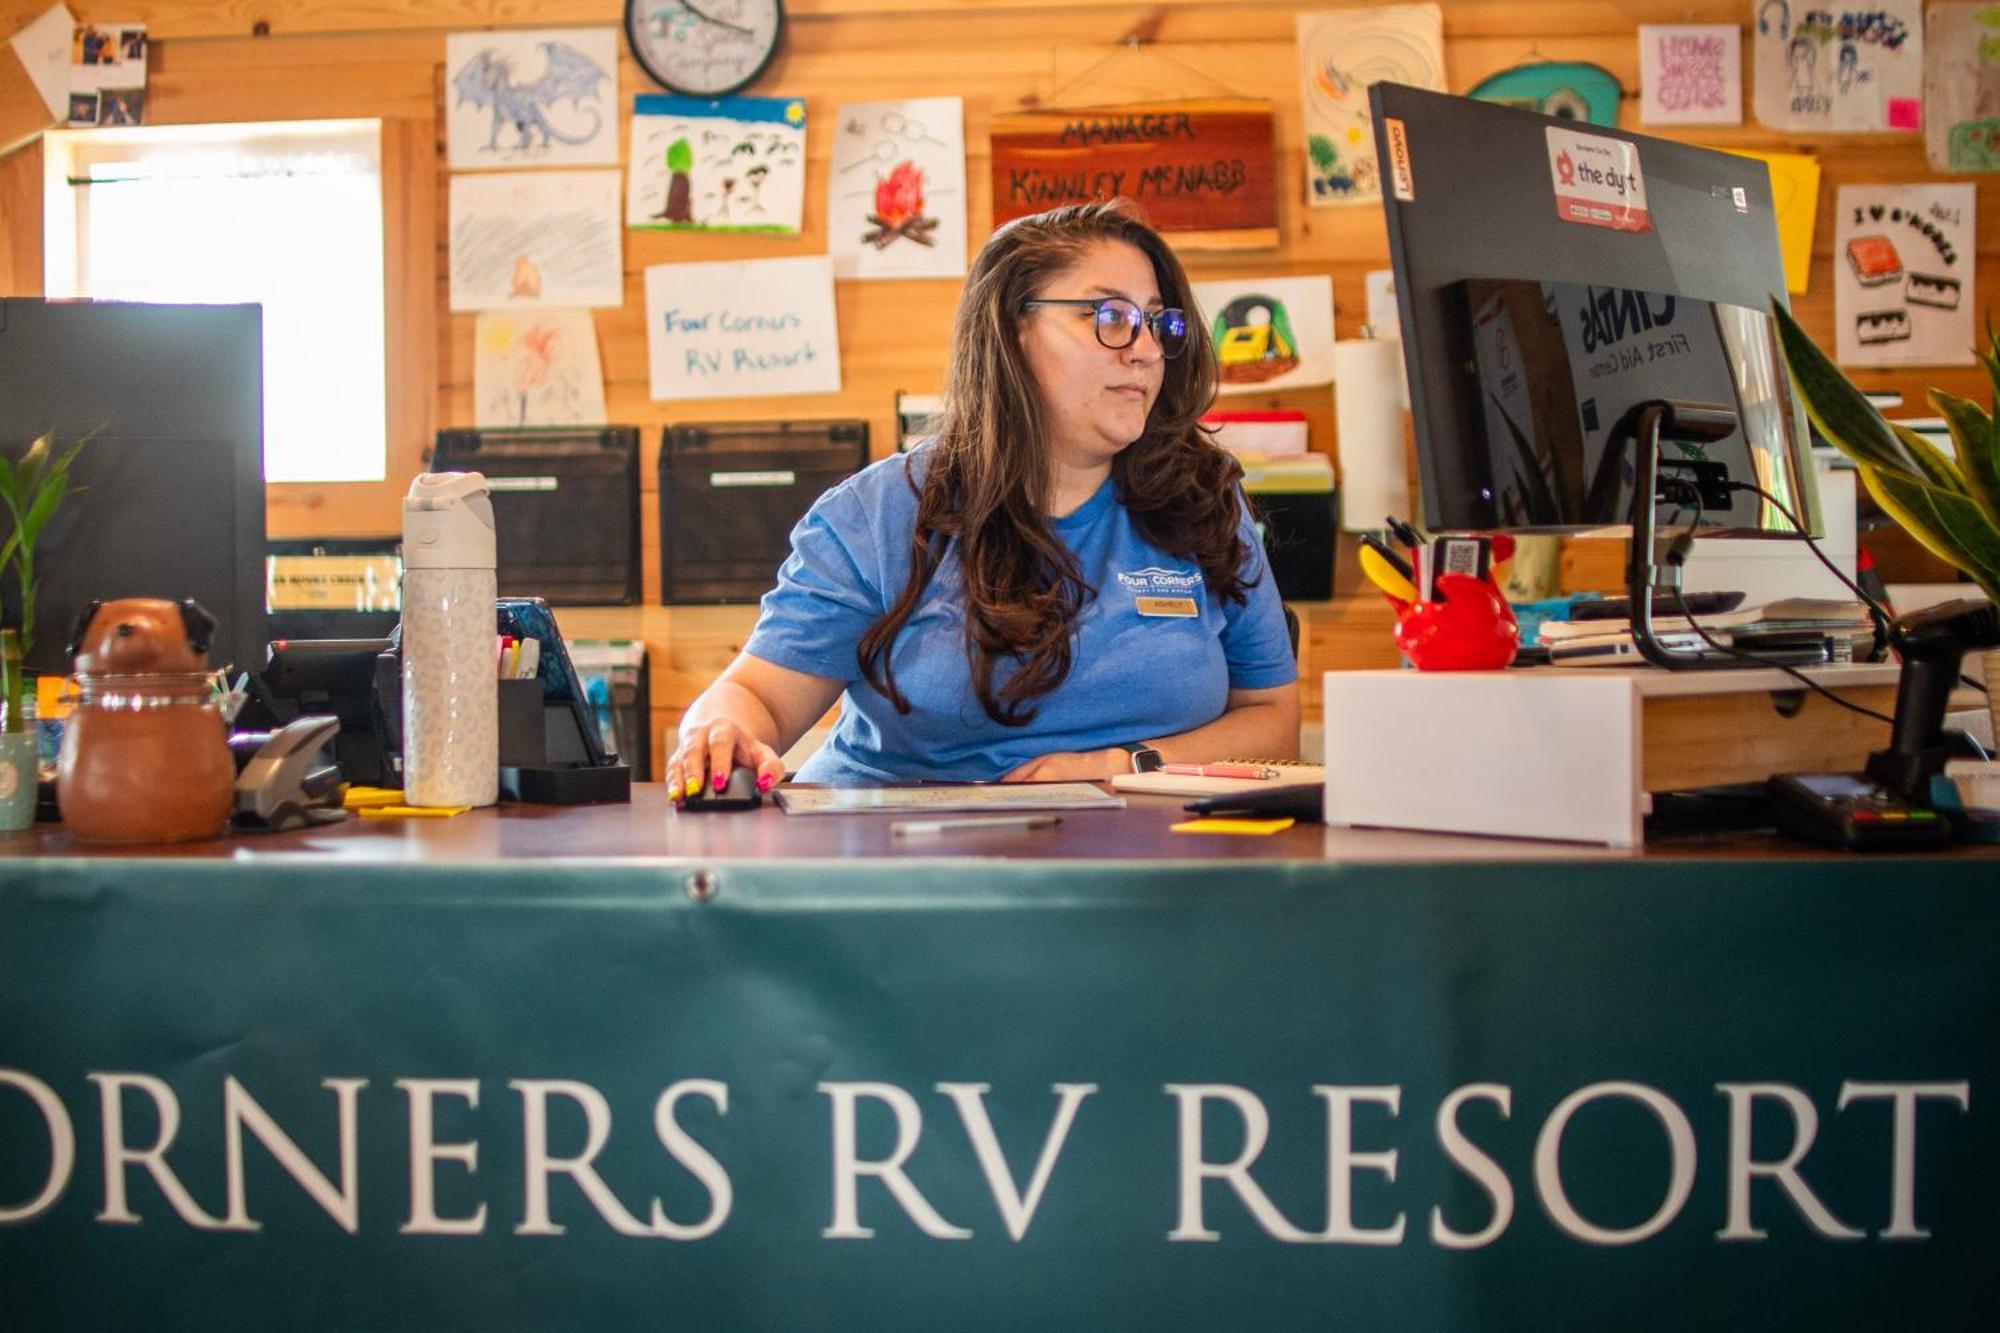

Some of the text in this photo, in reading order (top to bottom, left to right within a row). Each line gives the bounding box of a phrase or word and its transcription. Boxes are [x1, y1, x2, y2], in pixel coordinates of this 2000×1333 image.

[1059, 112, 1196, 146] MANAGER
[1391, 127, 1410, 193] Lenovo
[1577, 161, 1638, 196] the dyt
[664, 308, 804, 333] Four Corners
[684, 341, 817, 377] RV Resort
[1117, 571, 1203, 588] FOUR CORNERS
[815, 1080, 1099, 1243] RV
[1164, 1080, 1970, 1249] RESORT
